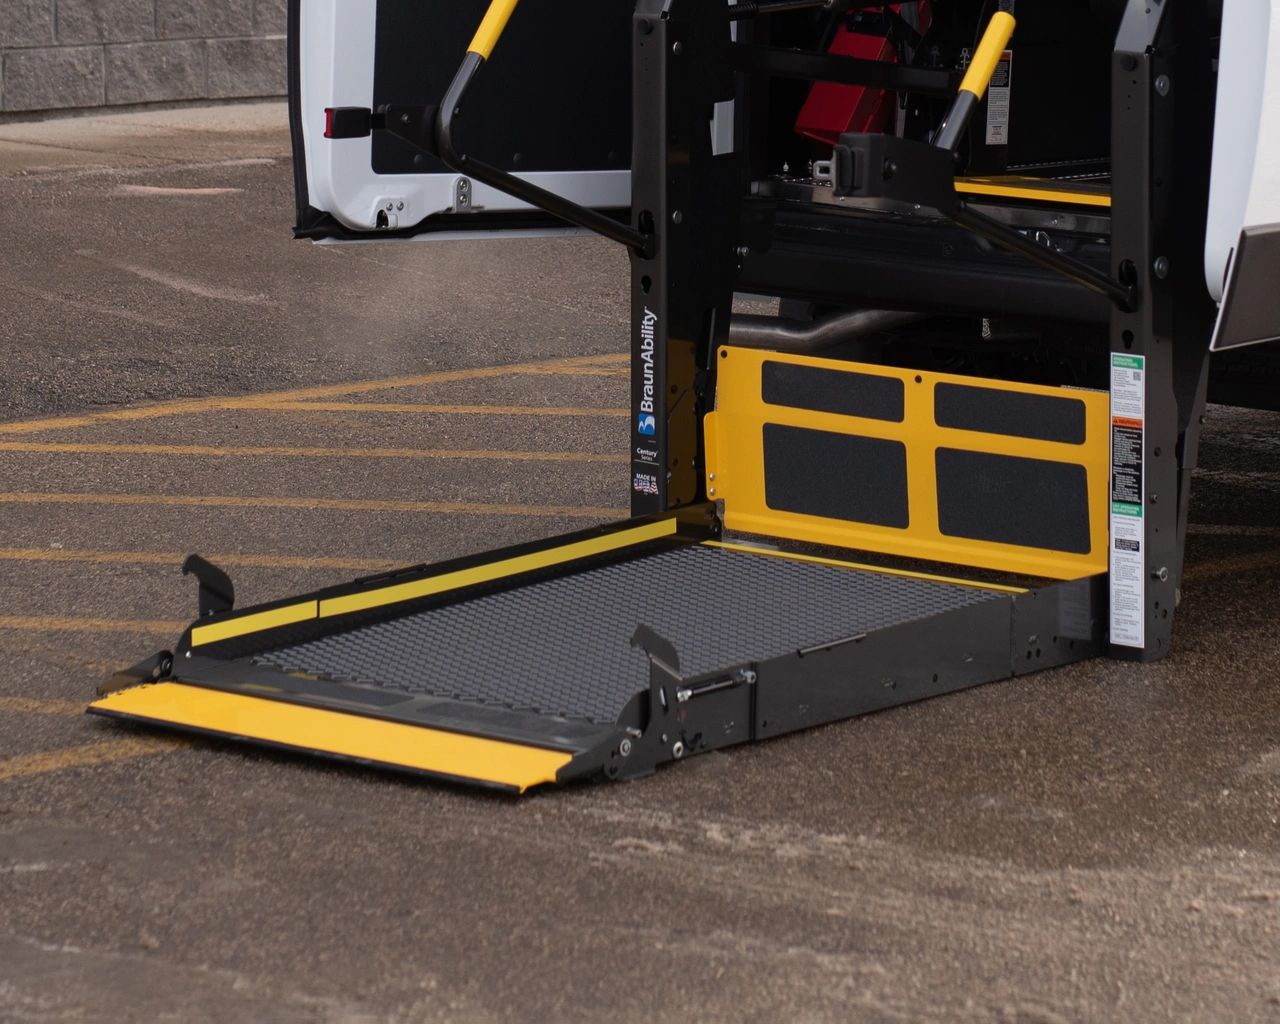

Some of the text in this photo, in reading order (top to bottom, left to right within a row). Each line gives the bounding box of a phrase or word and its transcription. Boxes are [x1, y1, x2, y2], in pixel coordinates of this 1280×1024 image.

[640, 308, 658, 413] BraunAbility
[636, 447, 657, 458] Century
[636, 472, 650, 482] MADE
